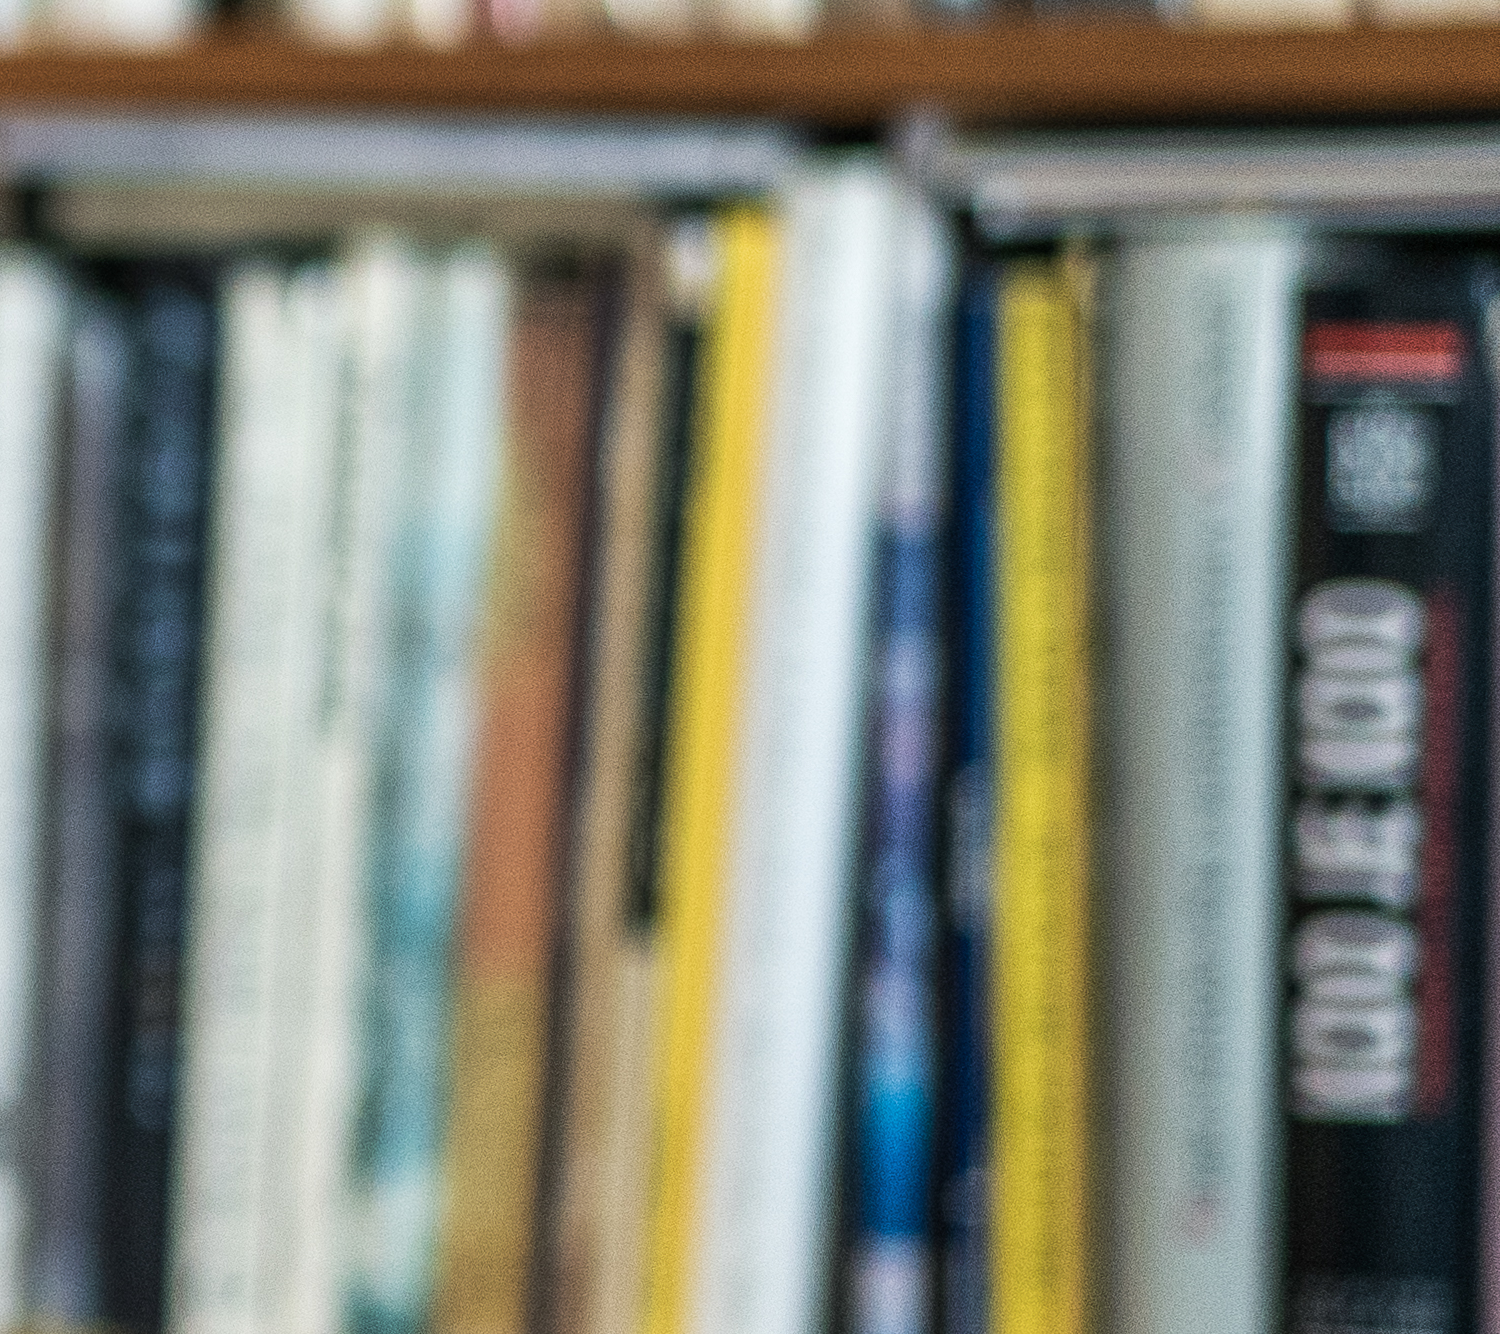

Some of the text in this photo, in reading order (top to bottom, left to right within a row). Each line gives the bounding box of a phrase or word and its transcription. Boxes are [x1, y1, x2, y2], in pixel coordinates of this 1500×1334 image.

[1297, 577, 1428, 790] KDO
[1295, 799, 1424, 899] JE
[1291, 909, 1420, 1123] KDO
